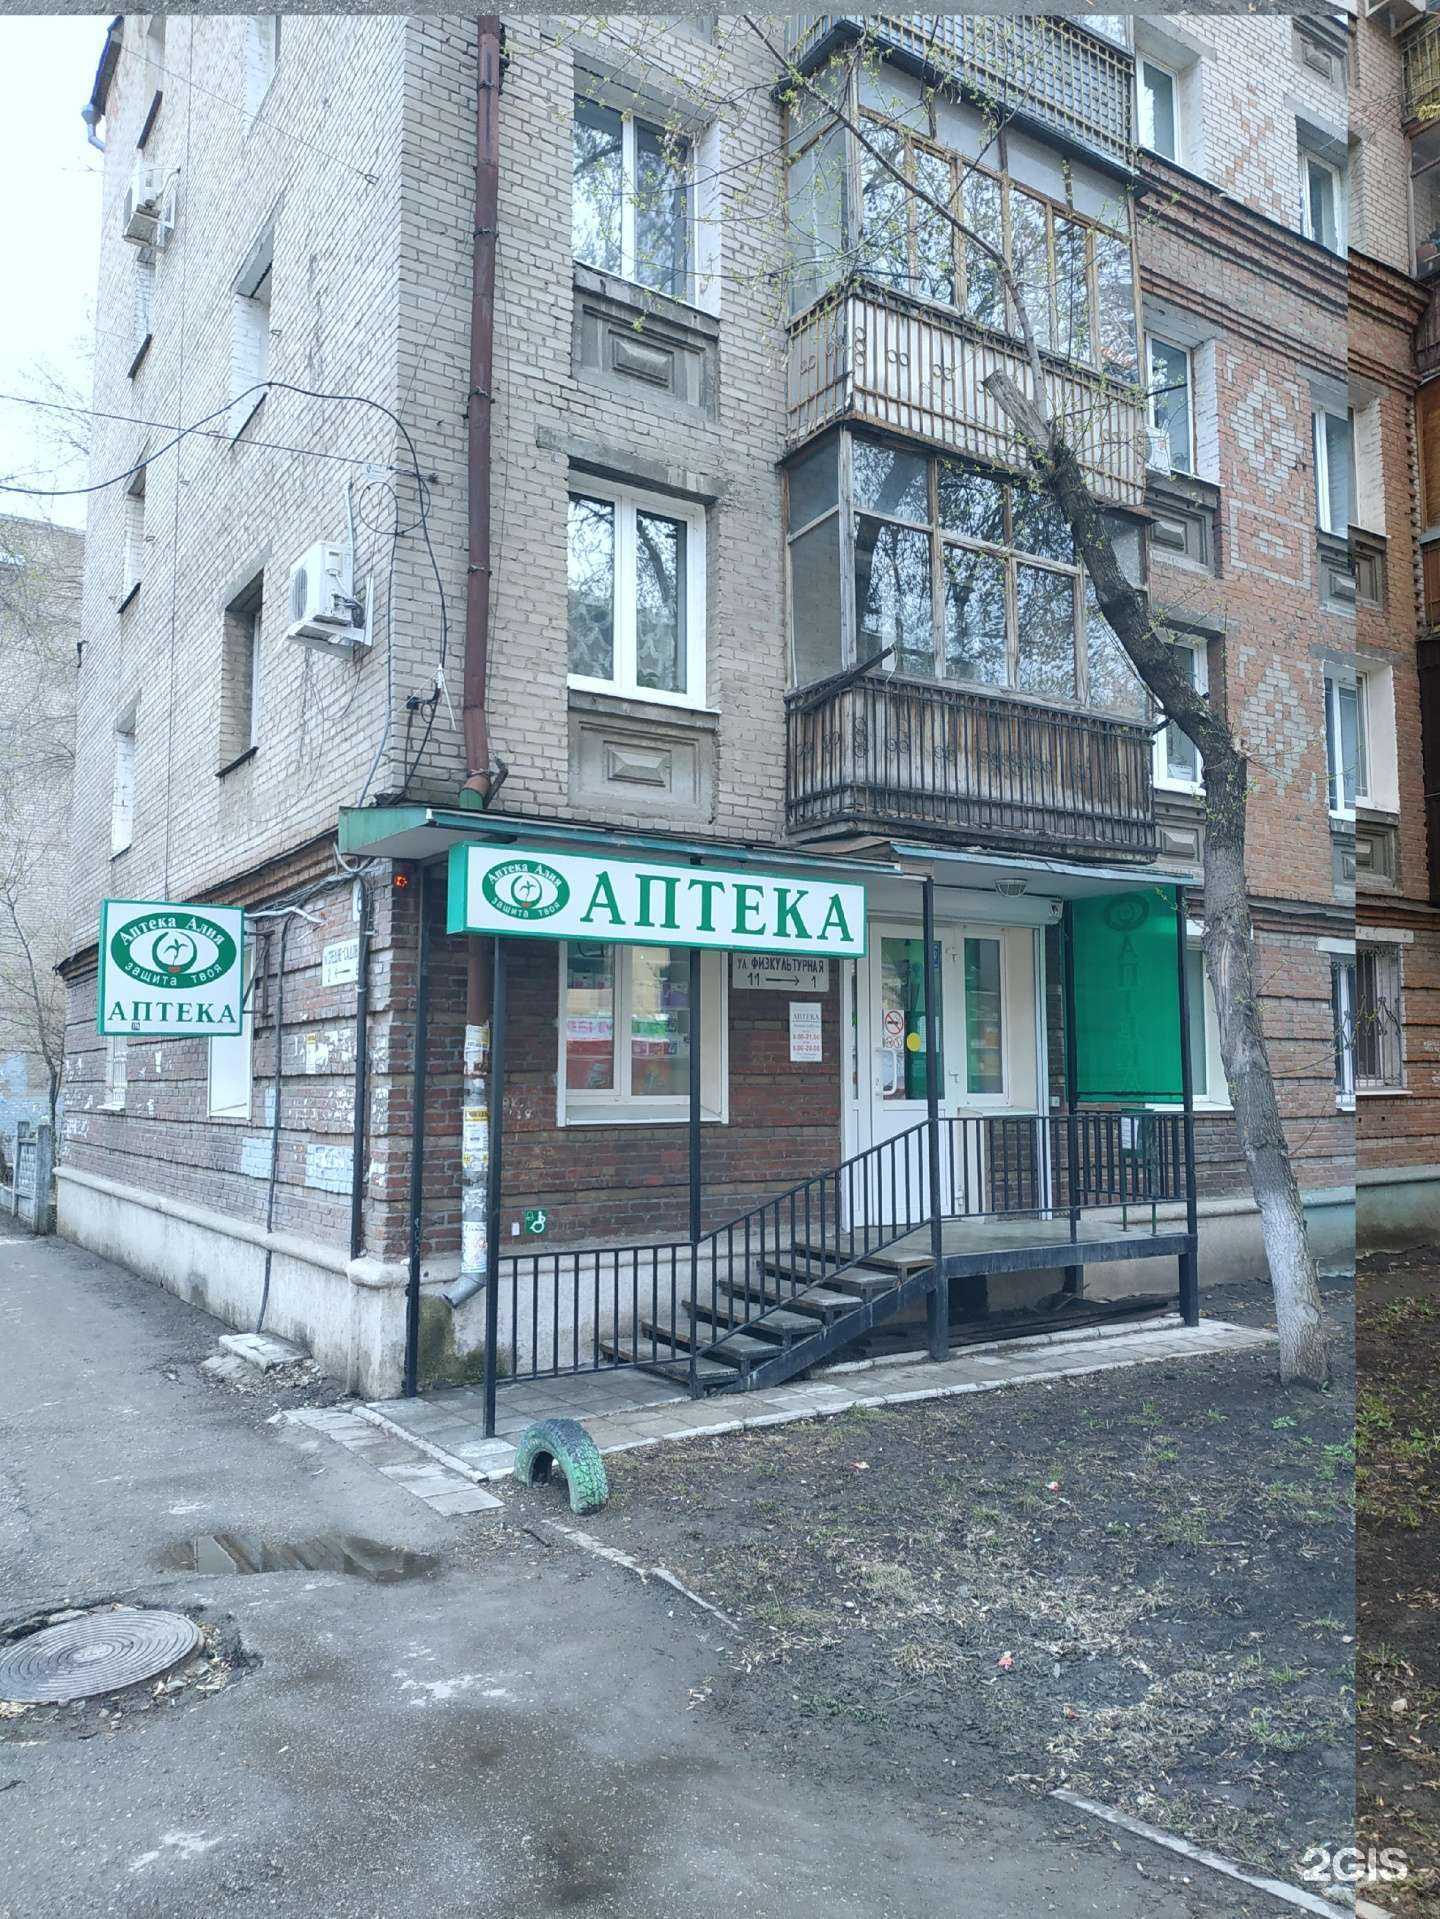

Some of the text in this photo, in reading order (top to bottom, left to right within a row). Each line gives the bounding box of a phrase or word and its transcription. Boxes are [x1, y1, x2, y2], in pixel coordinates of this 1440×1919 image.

[488, 863, 562, 887] Аптека Алия
[580, 870, 854, 942] АПТЕКА
[119, 917, 225, 946] Аптека Алия
[125, 962, 223, 986] защита твоя
[752, 957, 824, 973] ФИЗКУЛЬТУРНАЯ
[748, 972, 817, 988] 11 1
[108, 1001, 236, 1023] АПТЕКА
